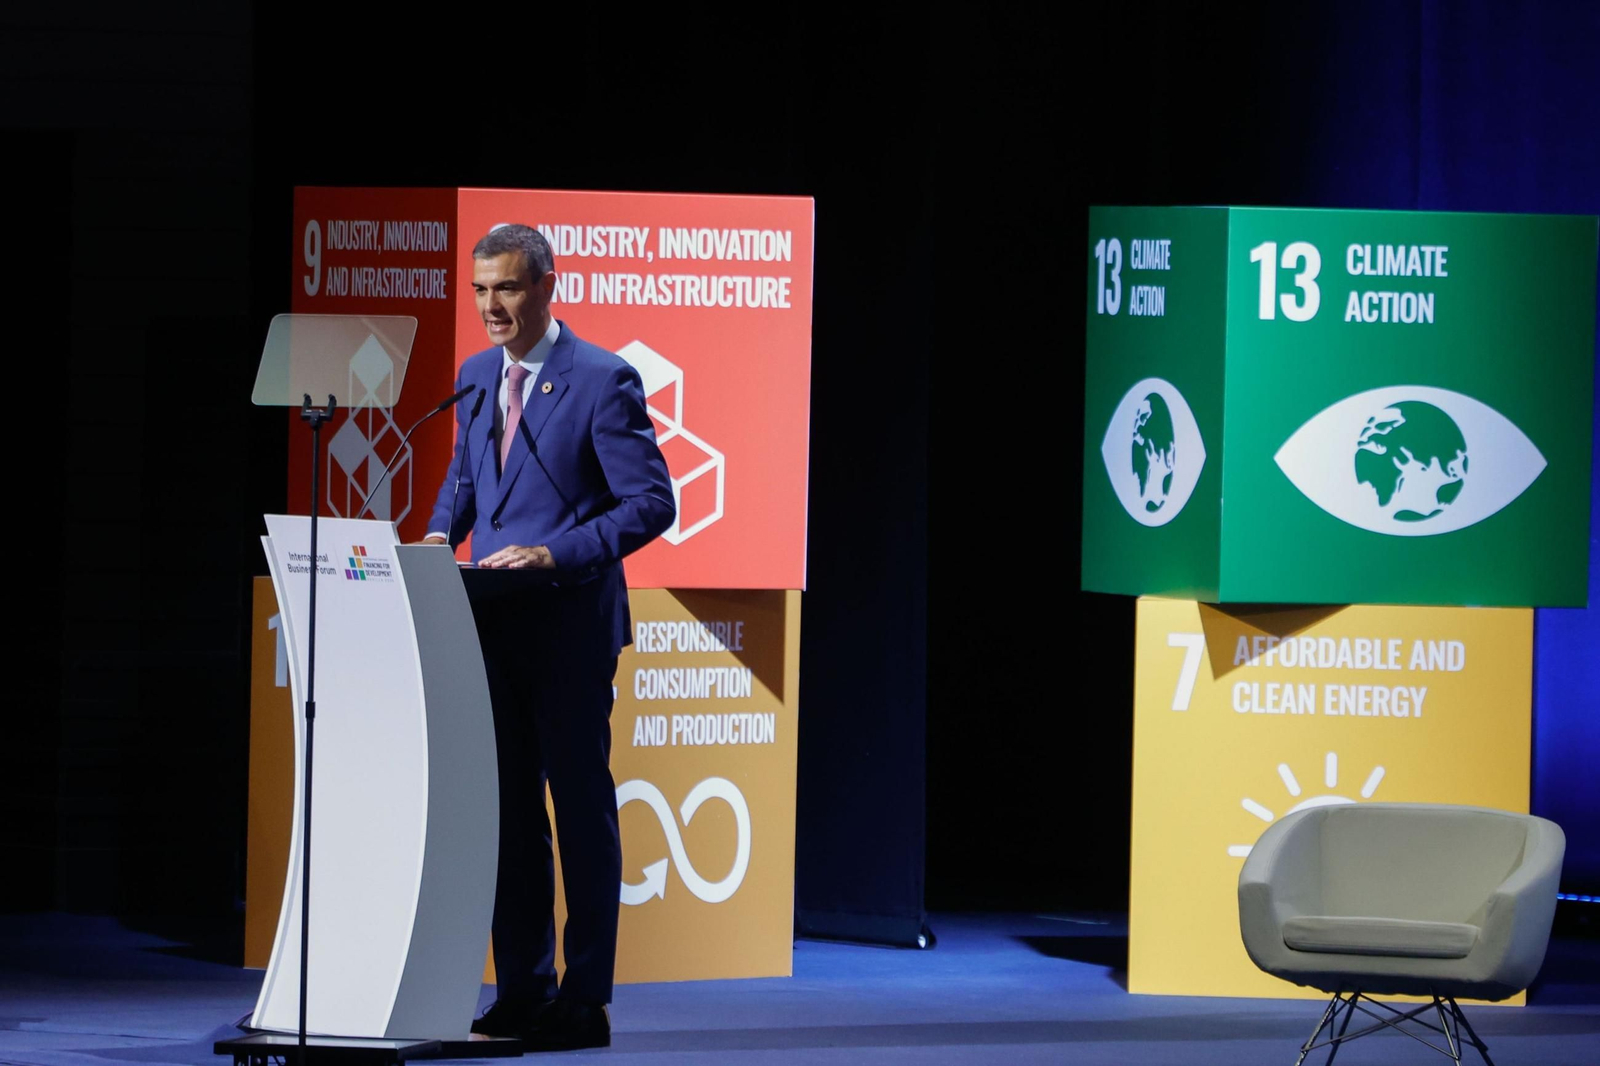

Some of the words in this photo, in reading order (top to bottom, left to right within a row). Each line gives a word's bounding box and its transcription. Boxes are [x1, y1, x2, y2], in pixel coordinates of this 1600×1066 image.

[327, 220, 382, 255] INDUSTRY,
[384, 221, 448, 252] INNOVATION
[537, 224, 654, 263] NDUSTRY,
[659, 228, 792, 262] INNOVATION
[304, 219, 321, 297] 9
[1130, 239, 1172, 271] CLIMATE
[1345, 244, 1449, 278] CLIMATE
[326, 267, 349, 297] AND
[352, 267, 447, 299] INFRASTRUCTURE
[549, 273, 584, 304] ND
[591, 274, 792, 309] INFRASTRUCTURE
[1094, 237, 1123, 317] 13
[1249, 240, 1322, 322] 13
[1129, 285, 1165, 317] ACTION
[1345, 291, 1435, 324] ACTION
[288, 552, 329, 562] Internaonal
[636, 621, 744, 653] RESPONSIBLE
[1233, 635, 1402, 671] AFFORDABLE
[1409, 640, 1465, 671] AND
[634, 667, 752, 700] CONSUMPTION
[1167, 632, 1207, 712] 7
[1232, 682, 1316, 715] CLEAN
[1324, 684, 1427, 718] ENERGY
[632, 715, 668, 747] AND
[672, 713, 775, 746] PRODUCTION
